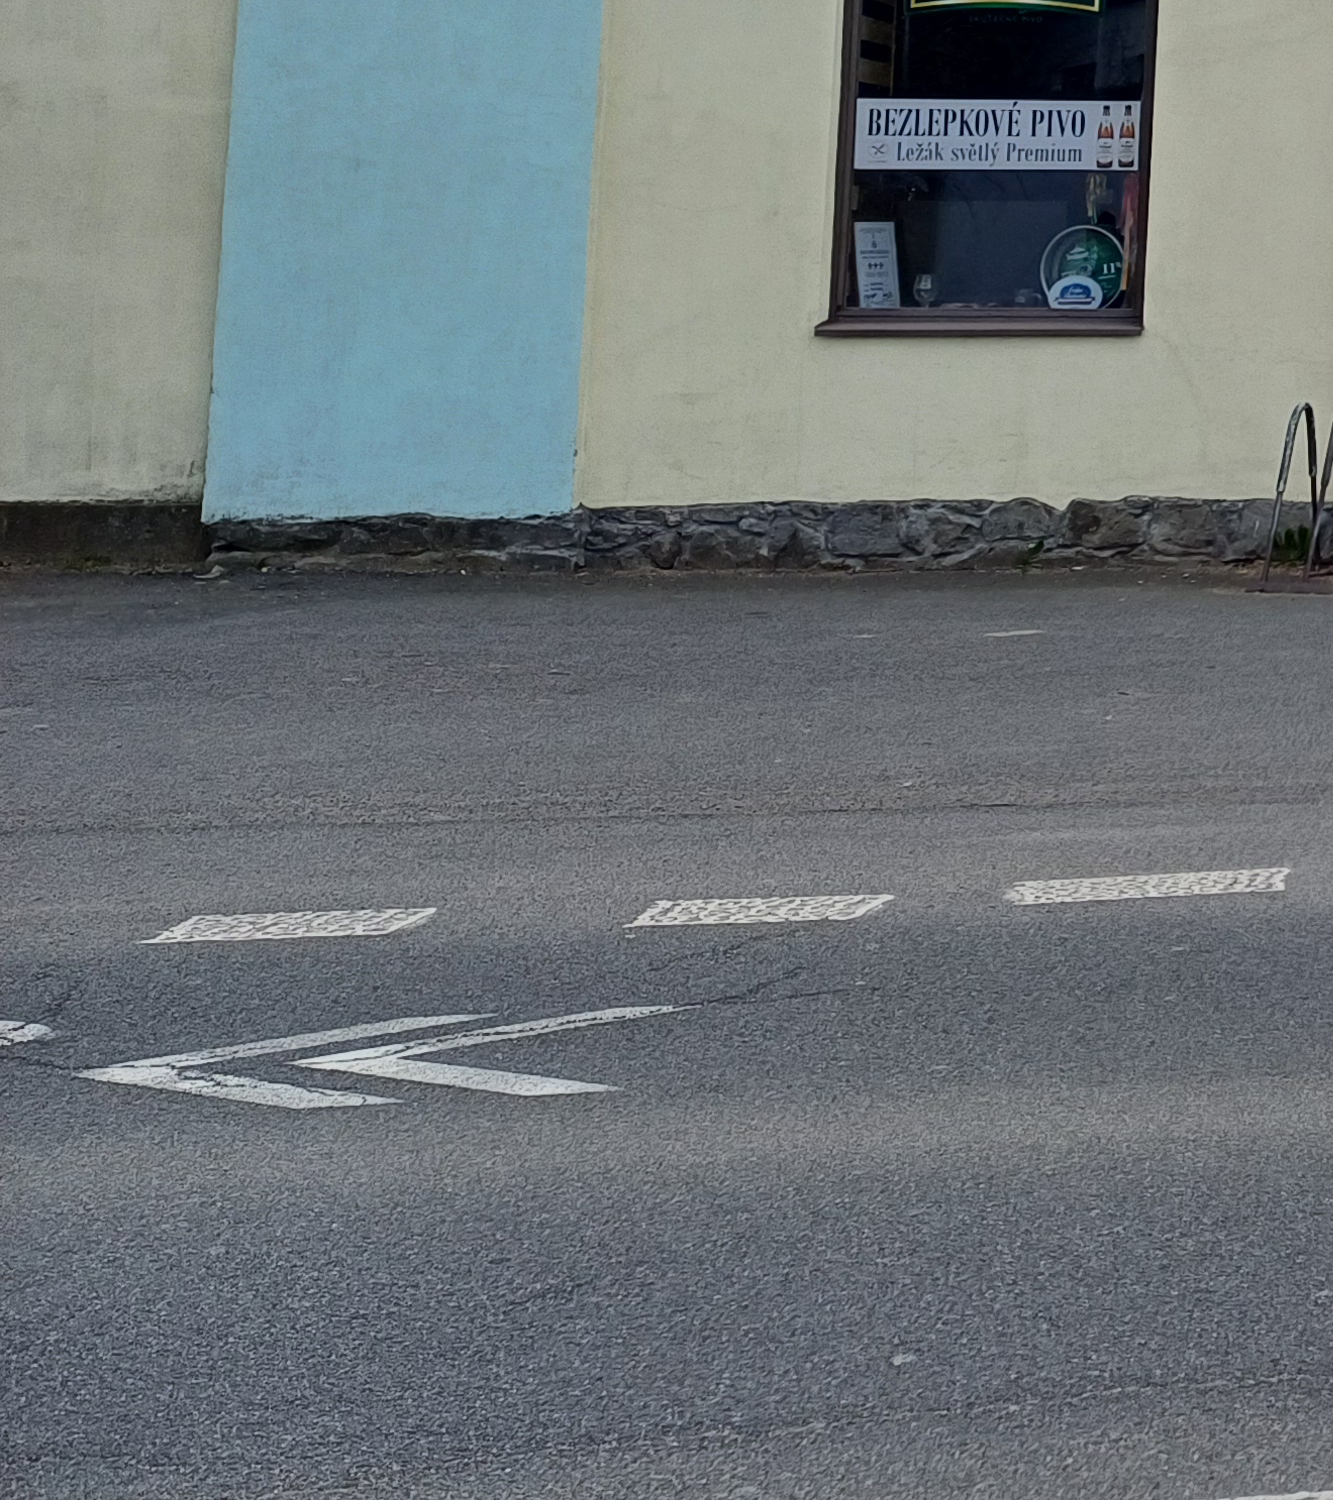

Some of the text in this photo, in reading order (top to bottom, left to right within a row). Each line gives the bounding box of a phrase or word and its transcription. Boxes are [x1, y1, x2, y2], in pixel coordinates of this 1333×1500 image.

[867, 102, 1086, 137] BEZLEPKOVÉ PIVO
[897, 142, 1083, 167] Ležák světlý Premium
